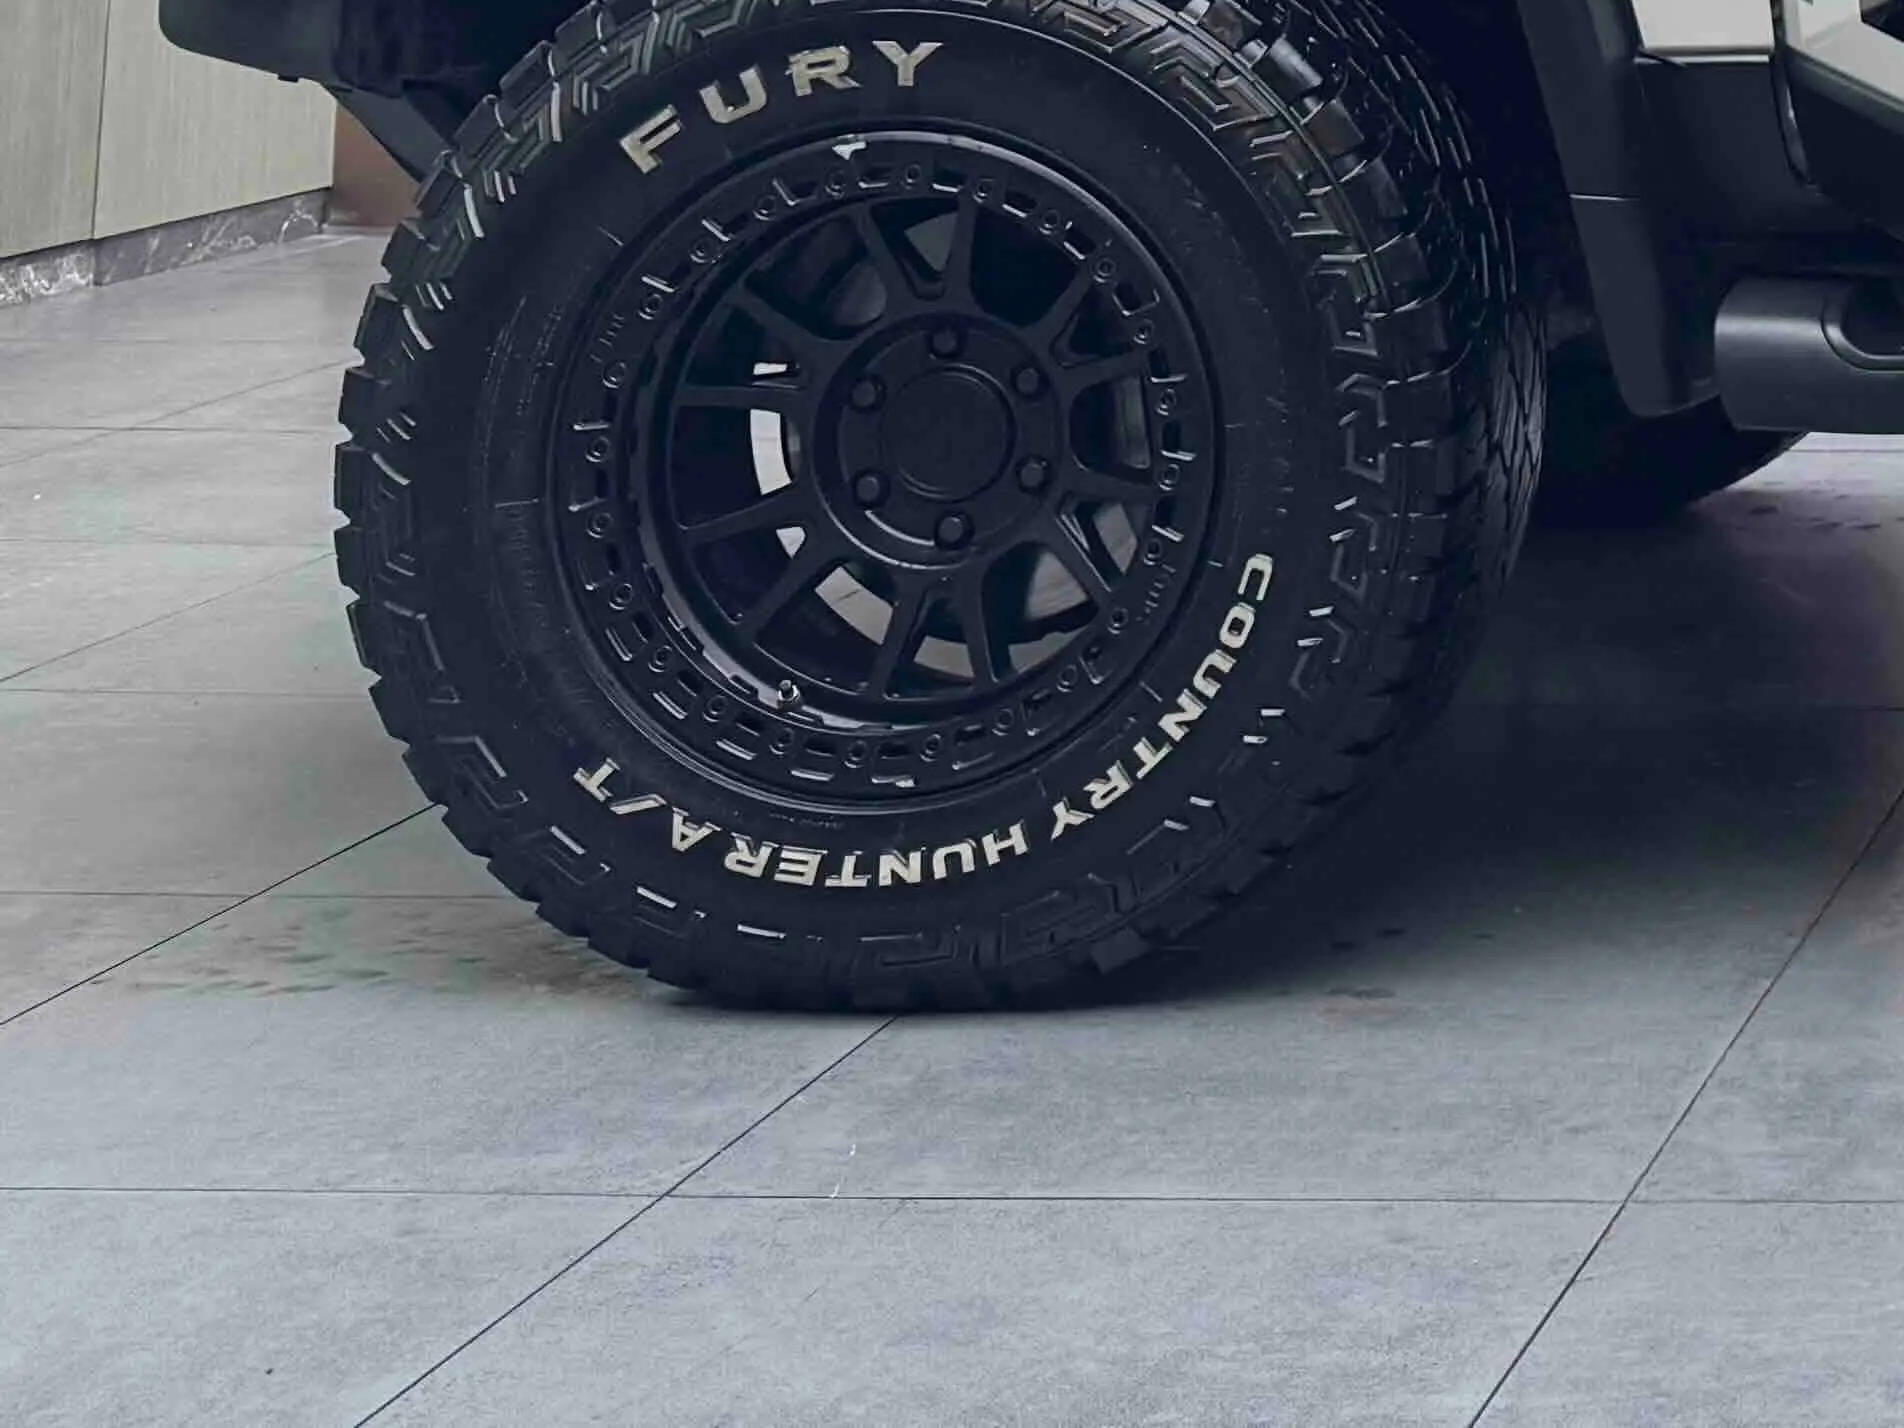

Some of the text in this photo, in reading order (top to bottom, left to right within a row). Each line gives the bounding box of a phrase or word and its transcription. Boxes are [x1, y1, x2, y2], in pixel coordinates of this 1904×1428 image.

[619, 40, 943, 174] FURY
[573, 553, 1273, 888] COUNTRY HUNTER A/T
